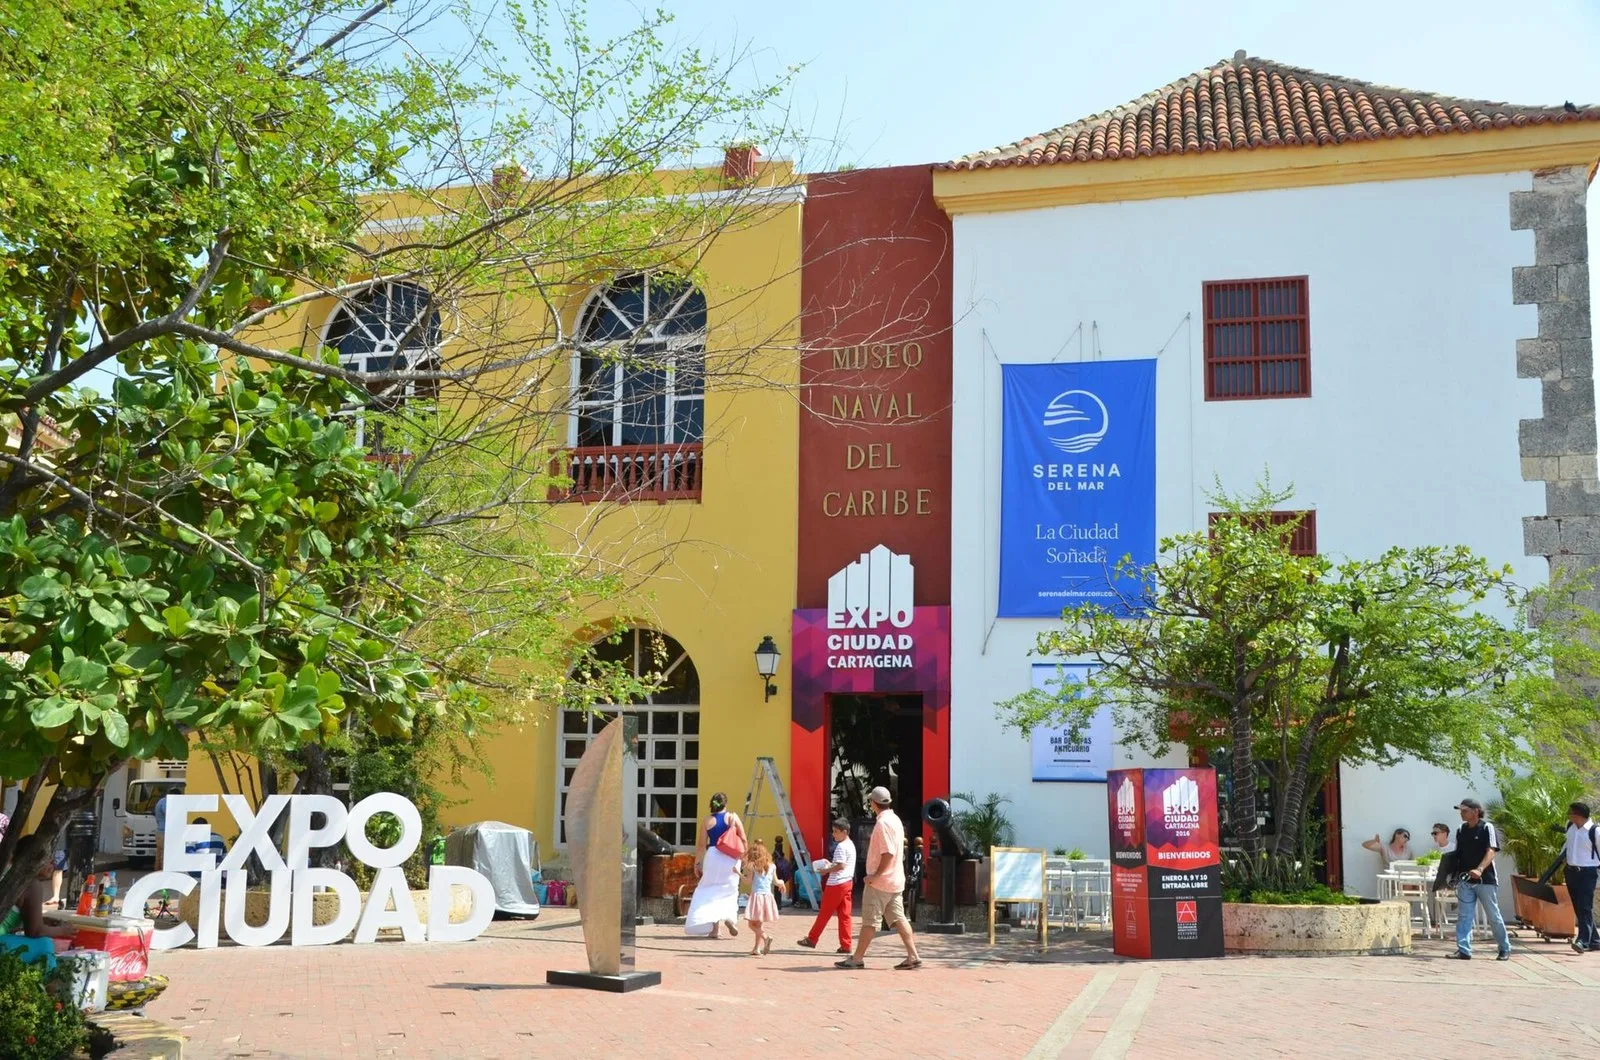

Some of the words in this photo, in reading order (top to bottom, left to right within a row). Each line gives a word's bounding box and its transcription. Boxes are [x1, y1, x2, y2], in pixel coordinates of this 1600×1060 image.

[832, 342, 923, 371] MUSEO
[832, 392, 922, 419] NAVAL
[846, 443, 901, 470] DEL
[1033, 463, 1121, 478] SERENA
[1048, 482, 1072, 491] DEL
[1077, 481, 1105, 490] MAR
[822, 488, 932, 517] CARIBE
[1035, 524, 1056, 540] La
[1059, 523, 1119, 540] Ciudad
[1046, 546, 1107, 564] Soñada
[827, 606, 914, 628] EXPO
[827, 634, 914, 650] CIUDAD
[827, 655, 913, 668] CARTAGENA
[1164, 805, 1199, 815] EXPO
[163, 791, 423, 871] EXPO
[1158, 851, 1211, 860] BIENVENIDOS
[122, 865, 496, 951] CIUDAD
